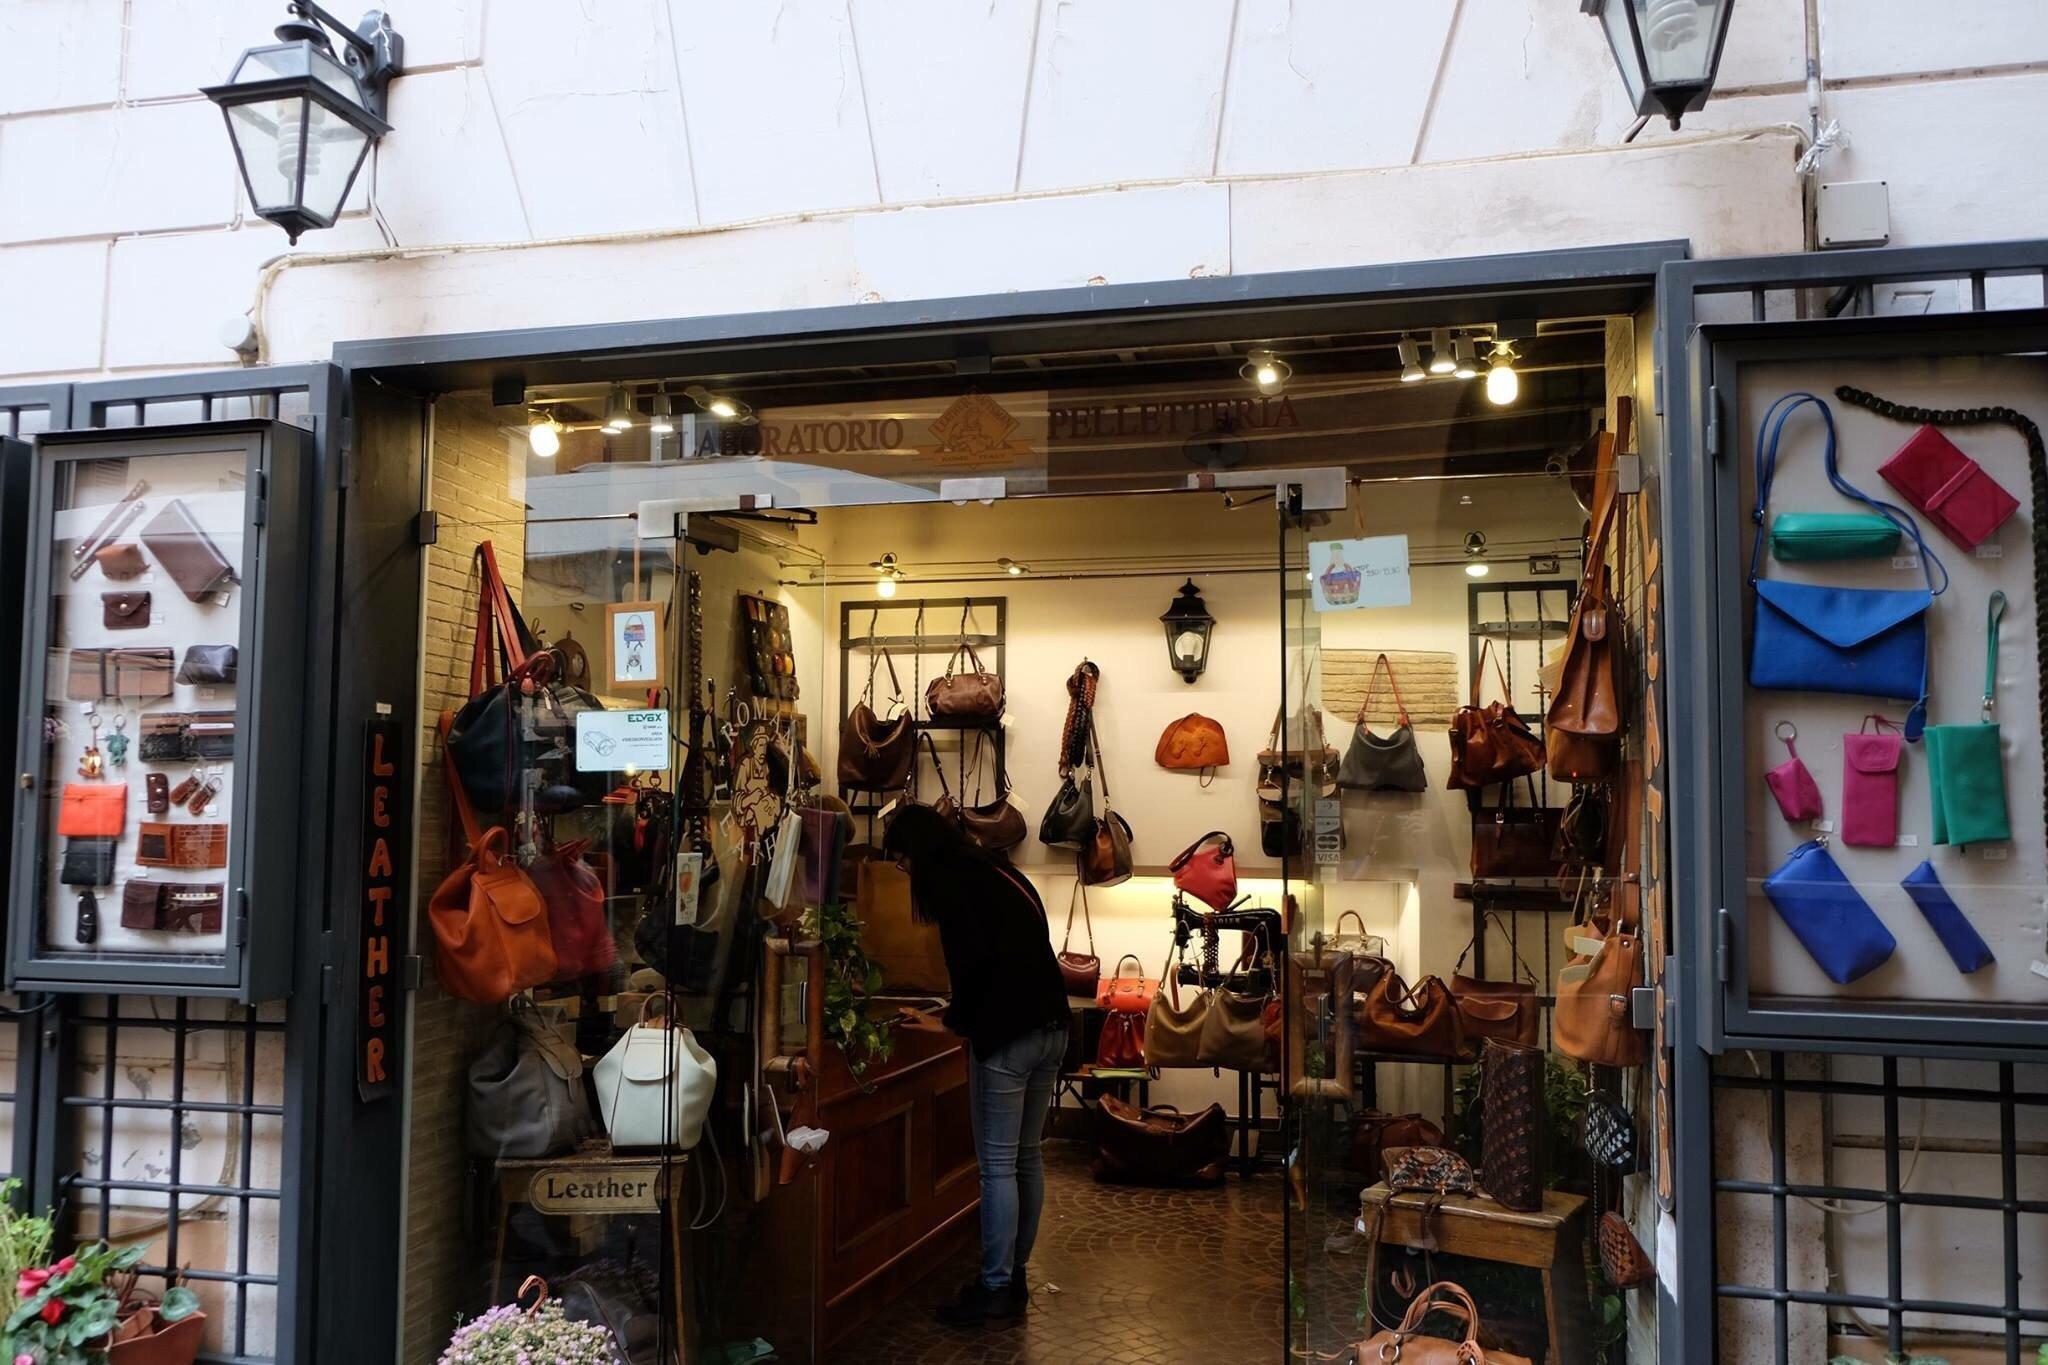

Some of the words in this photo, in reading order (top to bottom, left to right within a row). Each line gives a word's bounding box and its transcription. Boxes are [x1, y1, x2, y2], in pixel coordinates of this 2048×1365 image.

[677, 418, 904, 459] LABORATORIO
[1047, 395, 1299, 440] PELLETTERIA
[1317, 853, 1340, 862] VISA
[367, 733, 394, 1083] LEATHER
[547, 1177, 648, 1199] Leather
